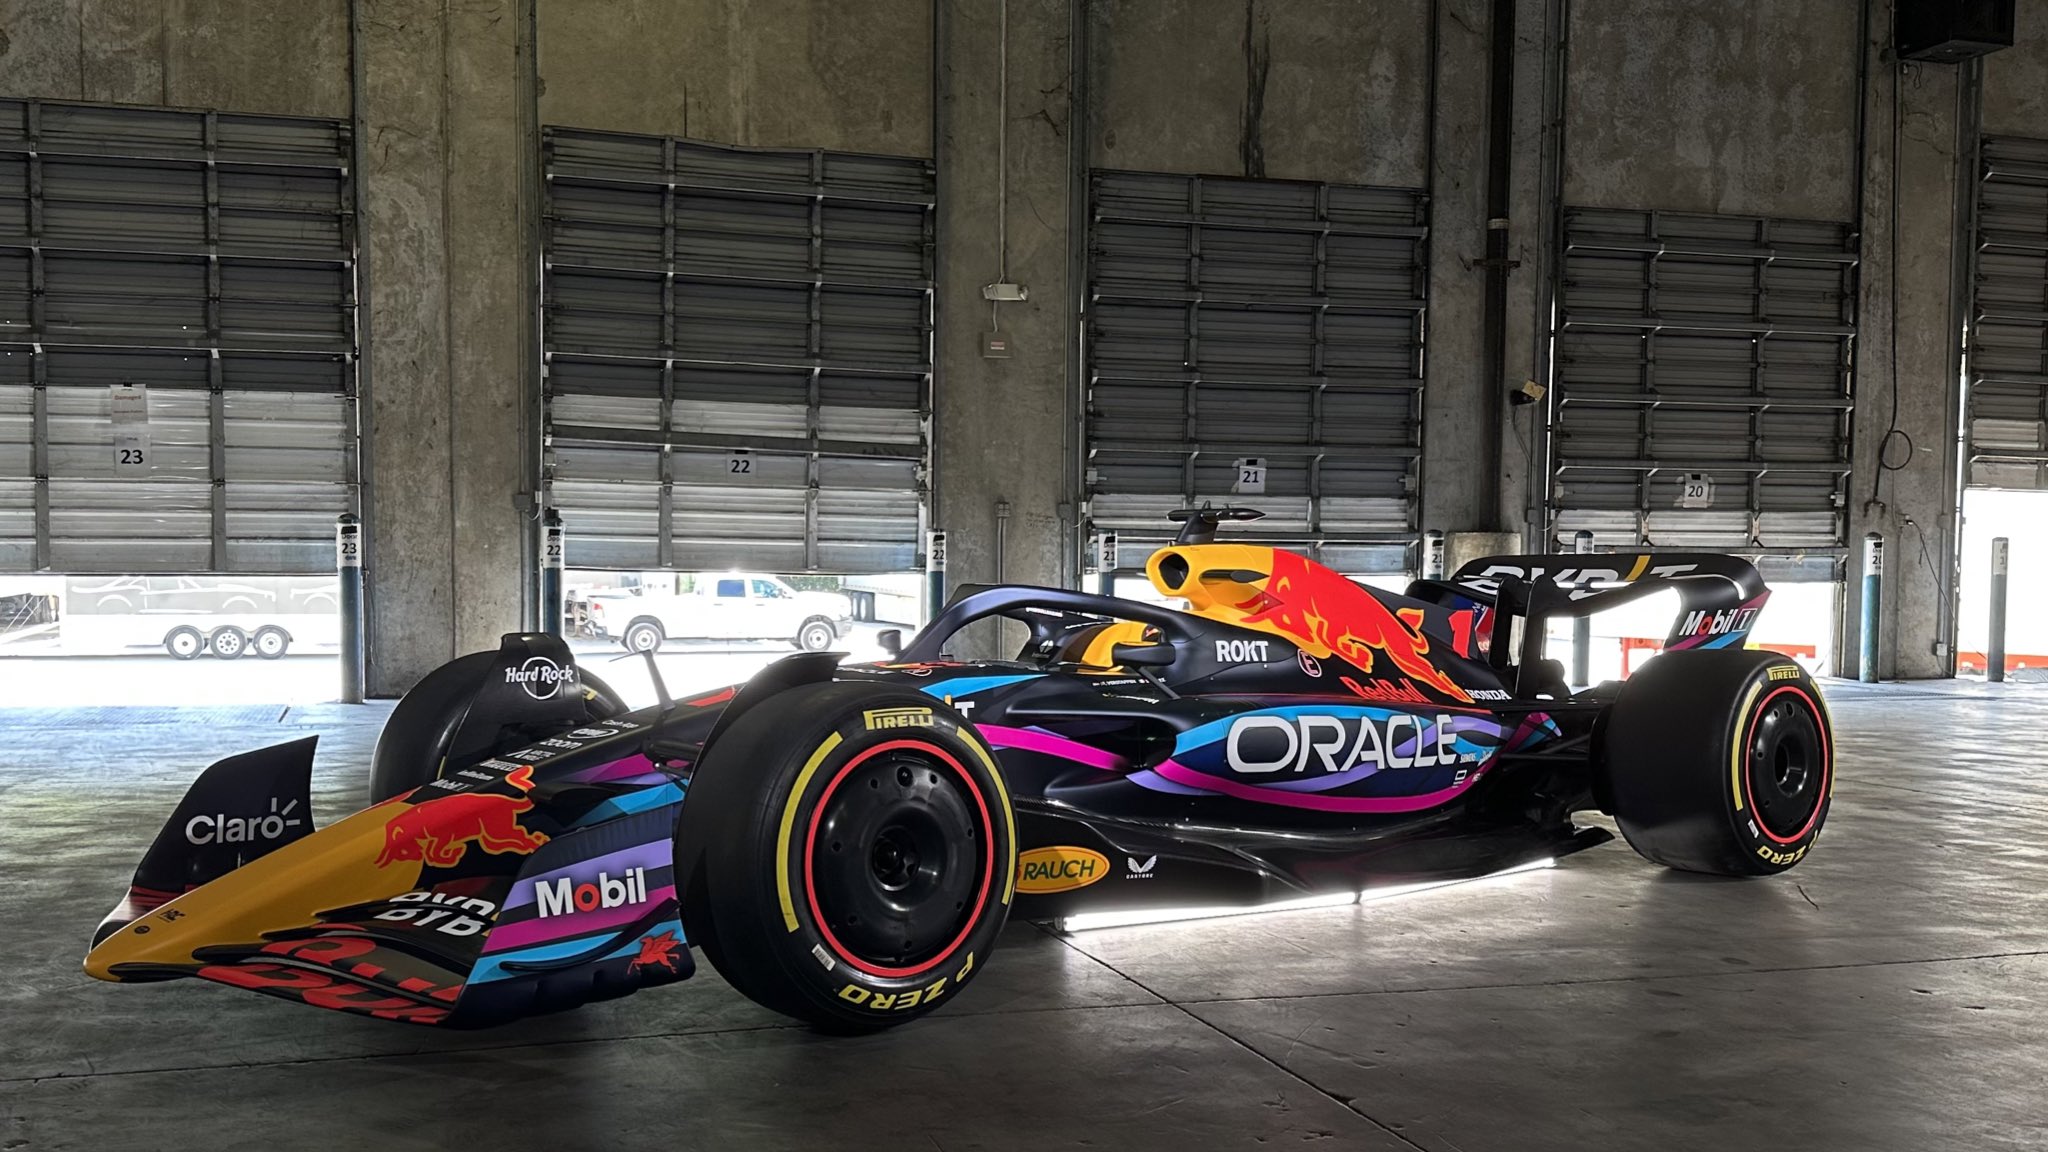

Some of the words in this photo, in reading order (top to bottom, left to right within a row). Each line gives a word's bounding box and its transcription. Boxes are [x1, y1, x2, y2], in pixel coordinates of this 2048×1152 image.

[120, 449, 144, 465] 23
[731, 459, 750, 473] 22
[1242, 470, 1259, 483] 21
[1688, 485, 1704, 498] 20
[341, 542, 357, 554] 23
[547, 544, 561, 556] 22
[932, 549, 945, 560] 22
[1103, 551, 1115, 561] 21
[1678, 608, 1739, 637] Mobil
[1737, 609, 1752, 631] 1
[1215, 639, 1269, 663] ROKT
[505, 666, 539, 683] Hard
[540, 664, 574, 685] Rock
[1766, 665, 1800, 681] PIRELLI
[1465, 689, 1512, 701] HONDA
[863, 706, 935, 731] PIRELLI
[1226, 713, 1458, 774] ORACLE
[185, 813, 285, 846] Claro
[1756, 843, 1808, 866] ZERO
[1023, 859, 1096, 881] RAUCH
[534, 866, 647, 919] Mobil
[955, 951, 974, 983] P
[837, 976, 949, 1011] ZERO
